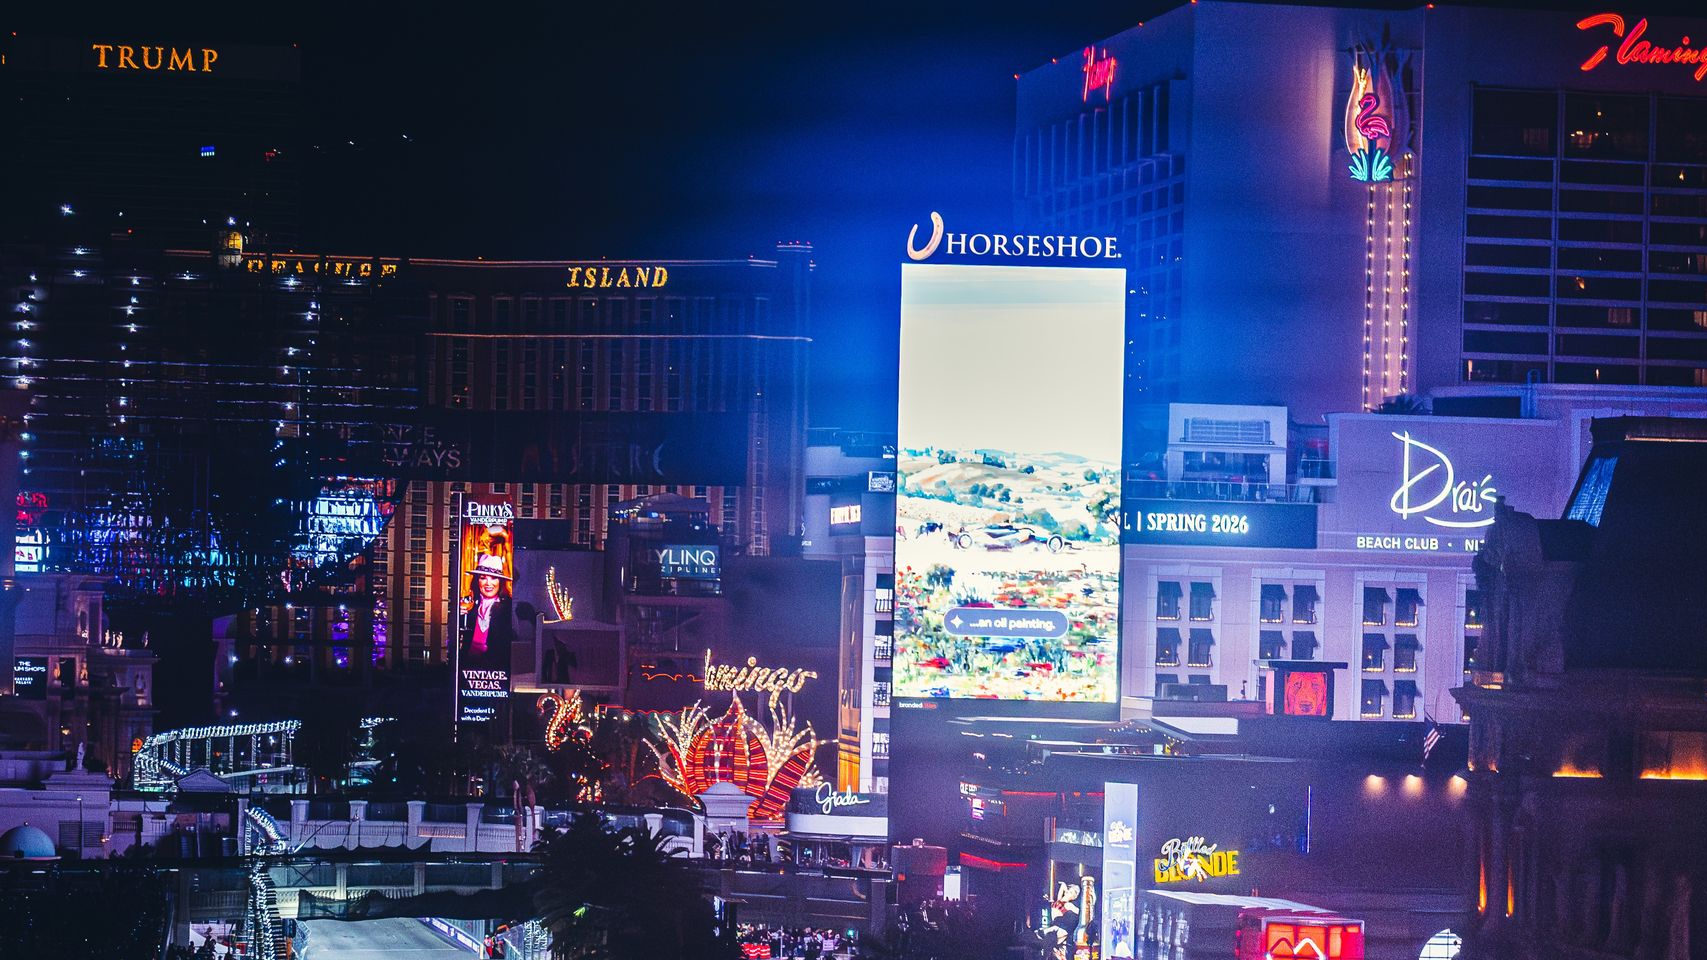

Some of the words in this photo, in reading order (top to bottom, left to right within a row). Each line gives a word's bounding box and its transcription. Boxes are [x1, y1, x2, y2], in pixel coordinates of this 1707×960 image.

[92, 44, 219, 72] TRUMP
[566, 266, 668, 288] ISLAND
[1146, 512, 1207, 532] SPRING
[1211, 514, 1249, 534] 2026
[1356, 536, 1400, 549] BEACH
[1404, 537, 1439, 550] CLUB
[461, 690, 509, 698] VANDERPUMP.
[468, 680, 502, 690] VEGAS.
